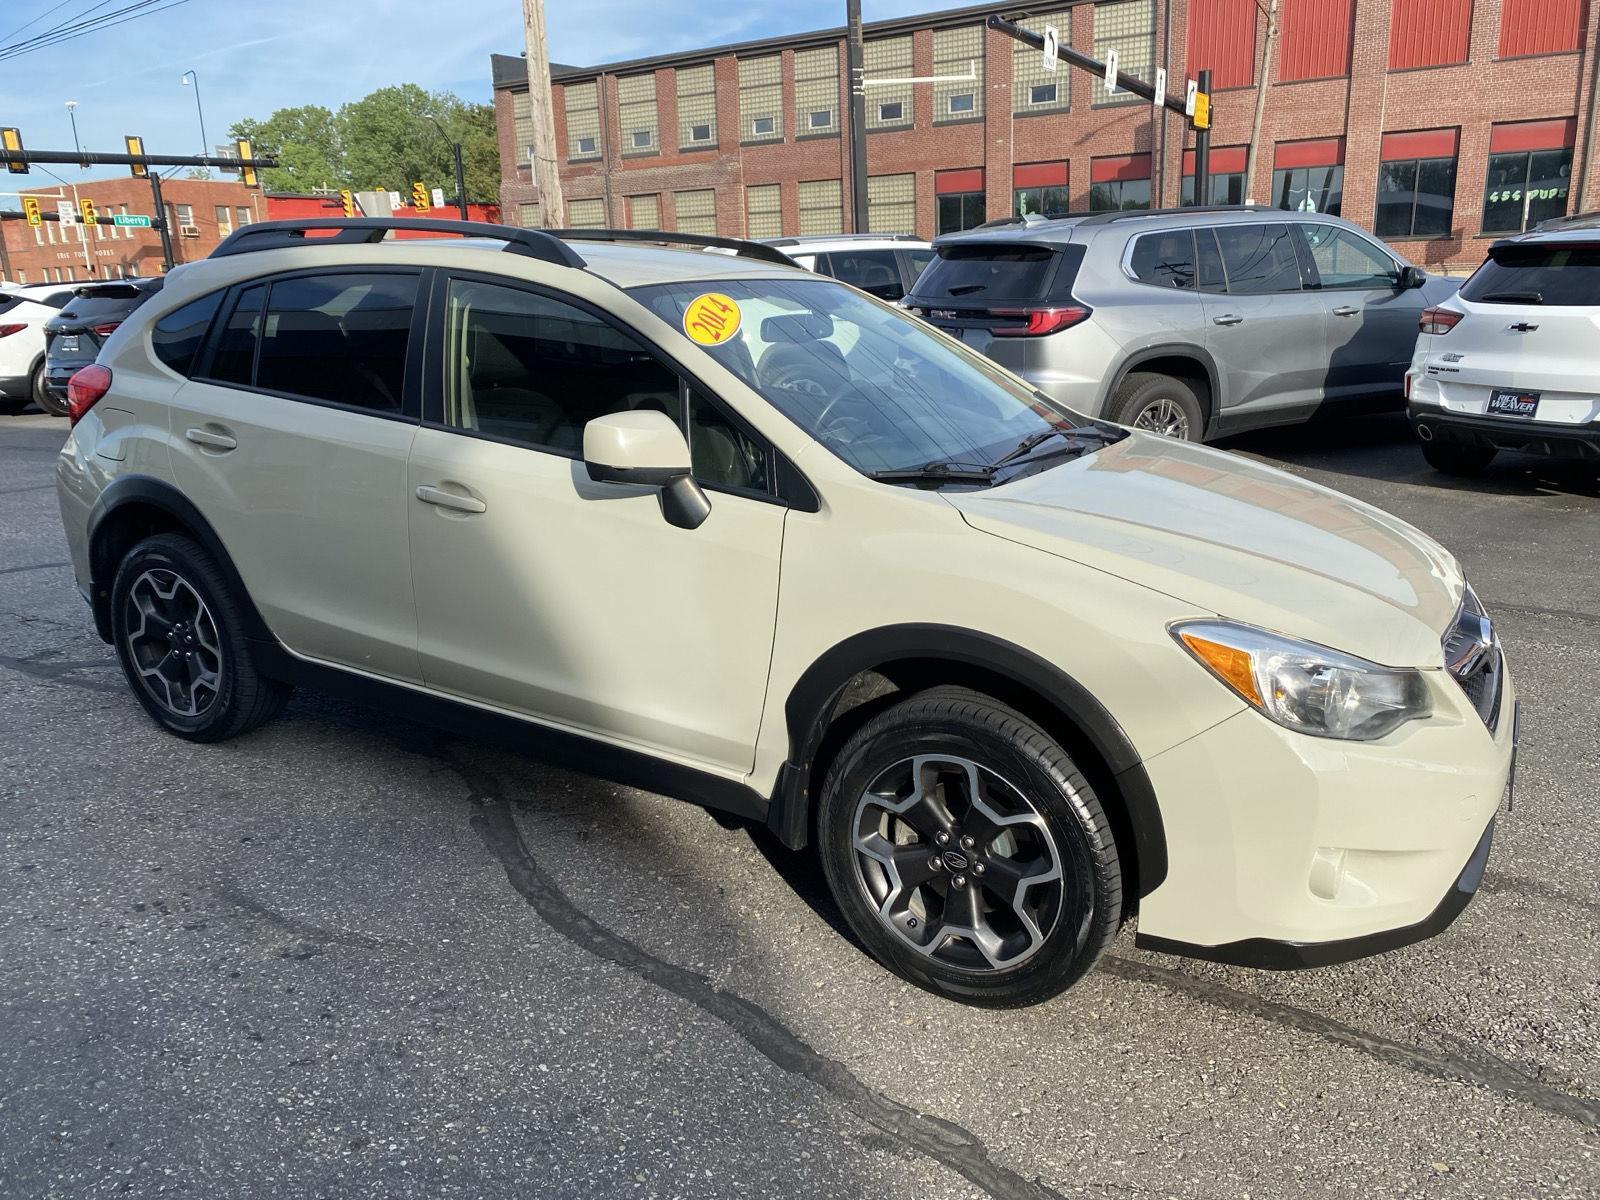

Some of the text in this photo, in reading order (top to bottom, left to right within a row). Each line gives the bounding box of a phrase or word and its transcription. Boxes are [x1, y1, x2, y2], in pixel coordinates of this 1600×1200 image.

[118, 216, 147, 226] Liberty
[56, 252, 70, 260] ERIE
[692, 296, 734, 342] 2014
[1498, 394, 1519, 404] RICK
[1491, 399, 1536, 412] WEAVER
